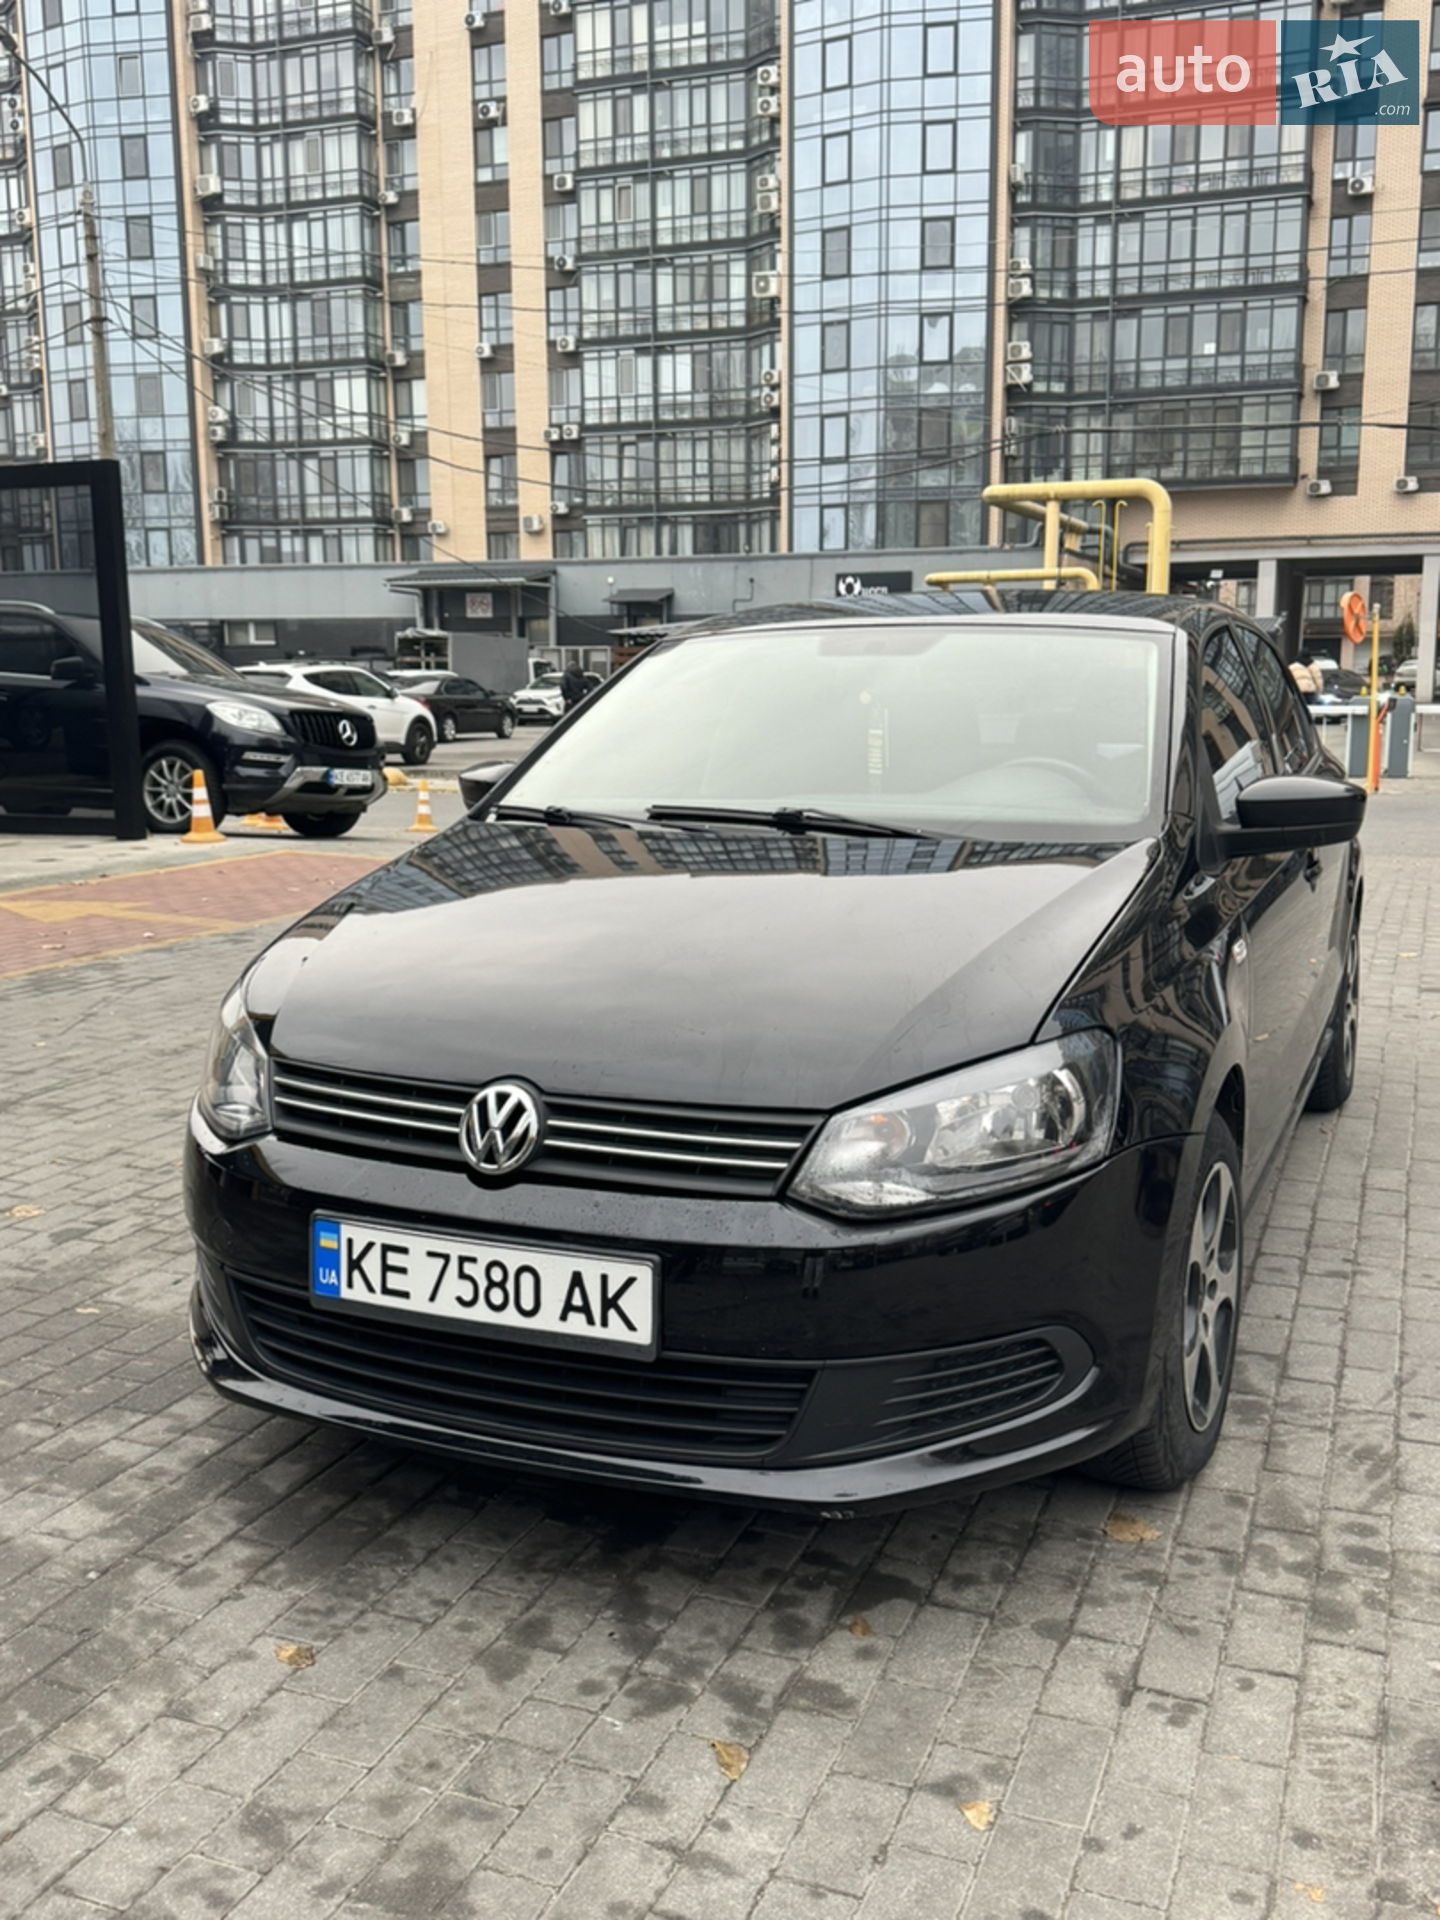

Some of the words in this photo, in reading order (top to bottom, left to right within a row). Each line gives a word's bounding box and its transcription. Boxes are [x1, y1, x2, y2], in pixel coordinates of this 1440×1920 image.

[319, 1267, 339, 1286] UA
[346, 1237, 411, 1300] KE
[426, 1251, 542, 1318] 7580
[559, 1270, 638, 1333] AK
